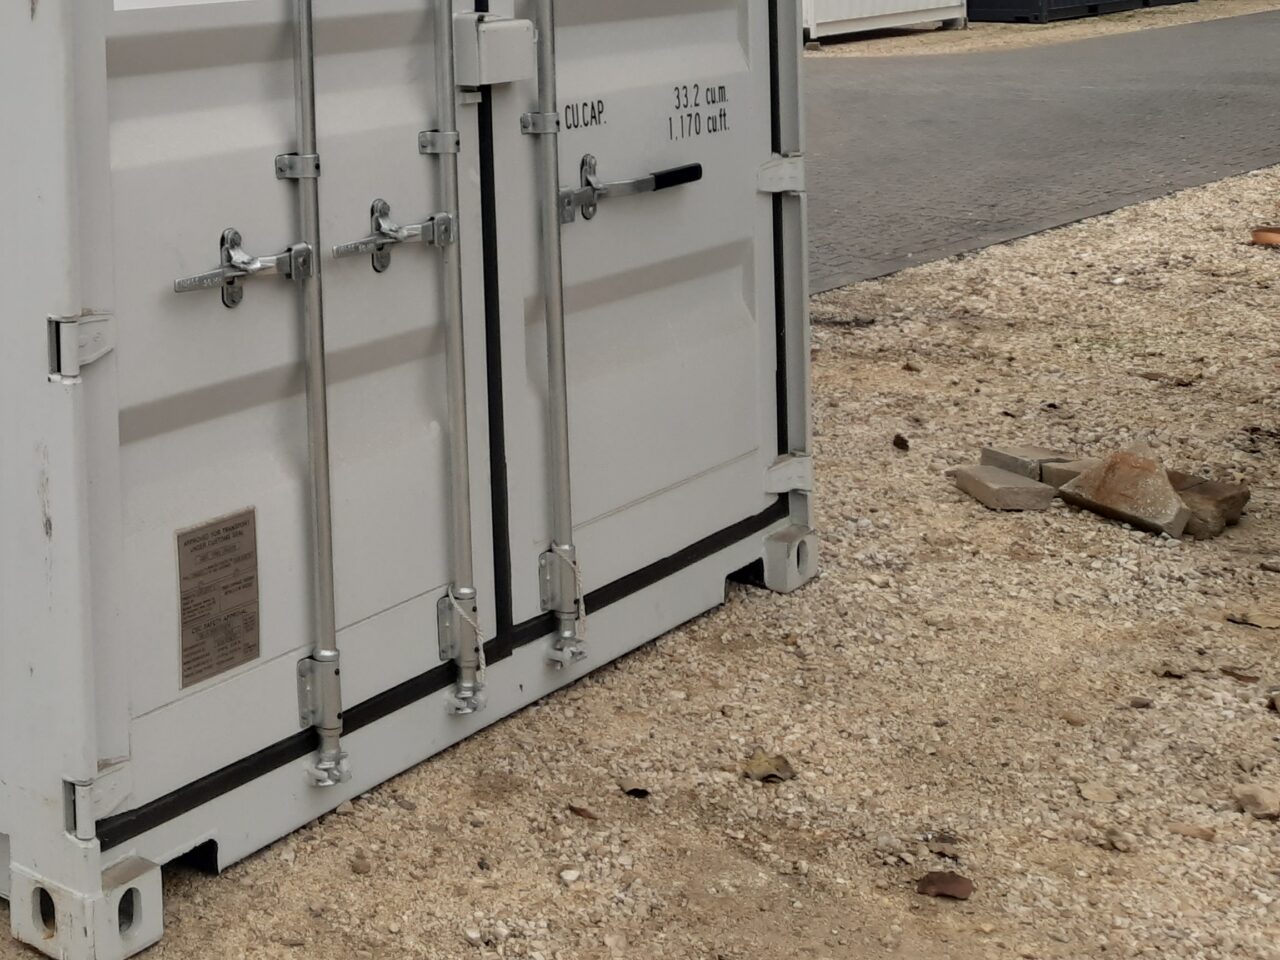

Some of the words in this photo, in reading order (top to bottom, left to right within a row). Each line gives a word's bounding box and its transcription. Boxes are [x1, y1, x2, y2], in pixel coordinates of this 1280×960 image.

[564, 100, 607, 130] CU.CAP.
[674, 83, 700, 110] 33.2
[705, 85, 729, 105] cu.m.
[706, 107, 730, 133] cu.ft.
